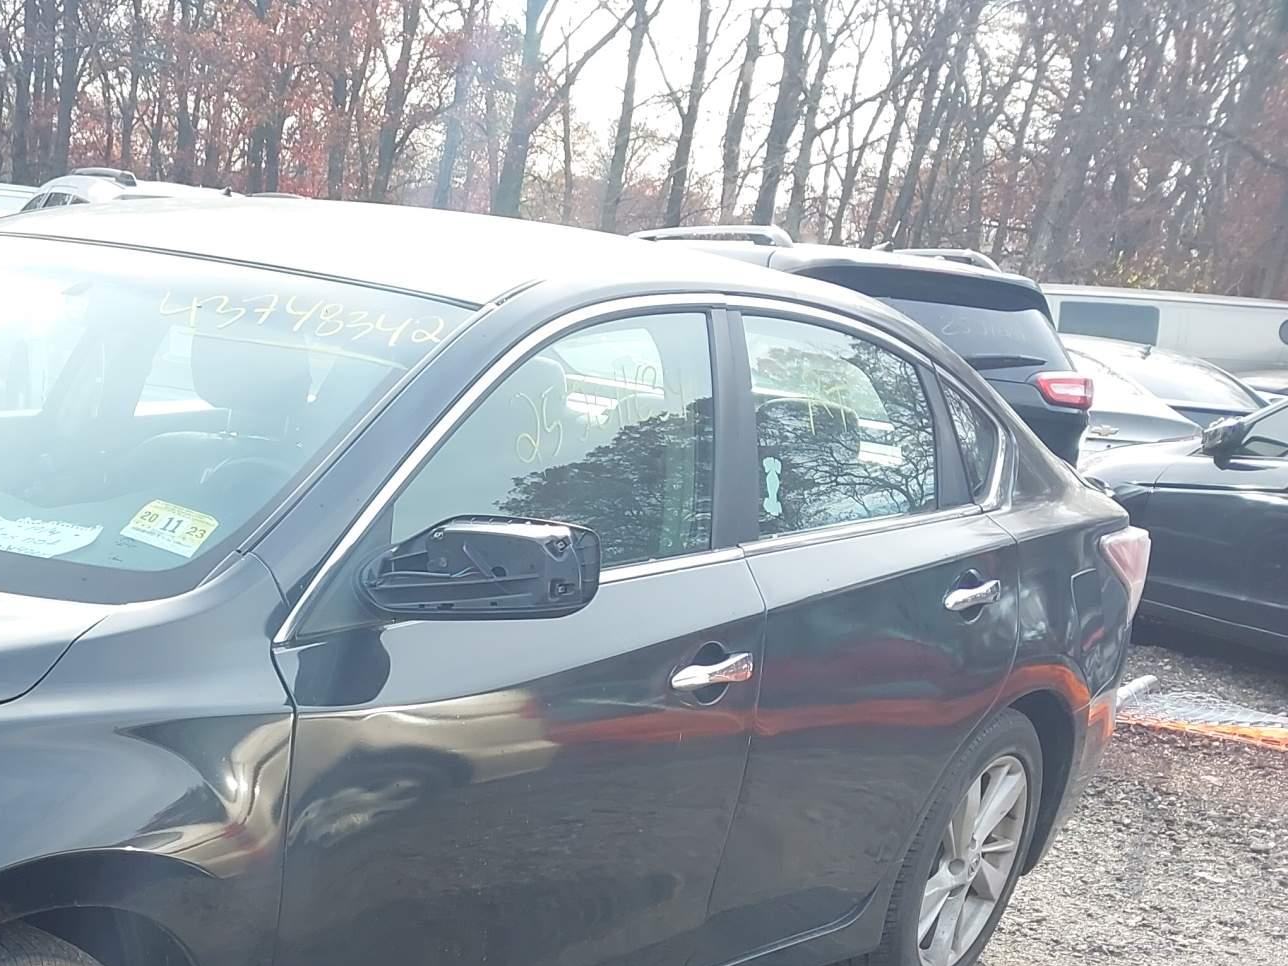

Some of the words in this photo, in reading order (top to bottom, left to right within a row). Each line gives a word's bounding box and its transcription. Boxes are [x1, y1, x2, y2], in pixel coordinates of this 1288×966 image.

[159, 290, 445, 347] 43748342
[139, 510, 160, 524] 20
[159, 516, 184, 534] 11
[185, 525, 207, 540] 23
